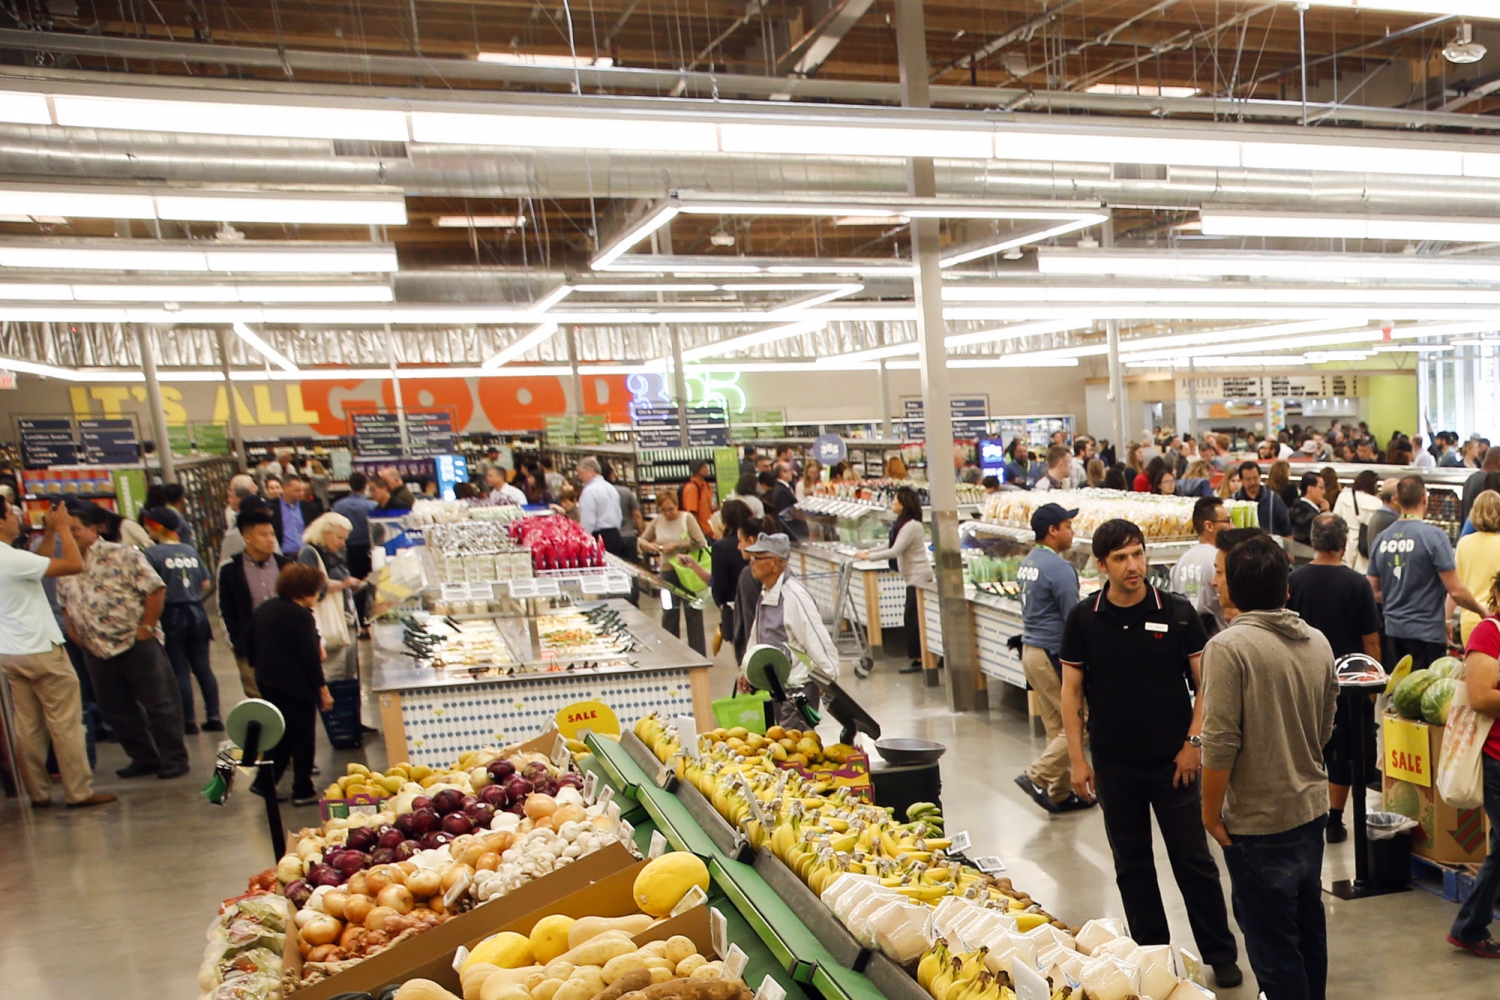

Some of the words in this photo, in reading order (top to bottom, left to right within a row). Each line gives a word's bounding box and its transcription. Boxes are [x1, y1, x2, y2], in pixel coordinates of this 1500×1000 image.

[69, 385, 188, 426] IT'S
[212, 385, 319, 426] ALL
[1380, 538, 1415, 553] GOOD
[164, 557, 199, 569] GOOD
[1180, 563, 1202, 582] 365
[567, 710, 597, 723] SALE
[1391, 750, 1422, 775] SALE
